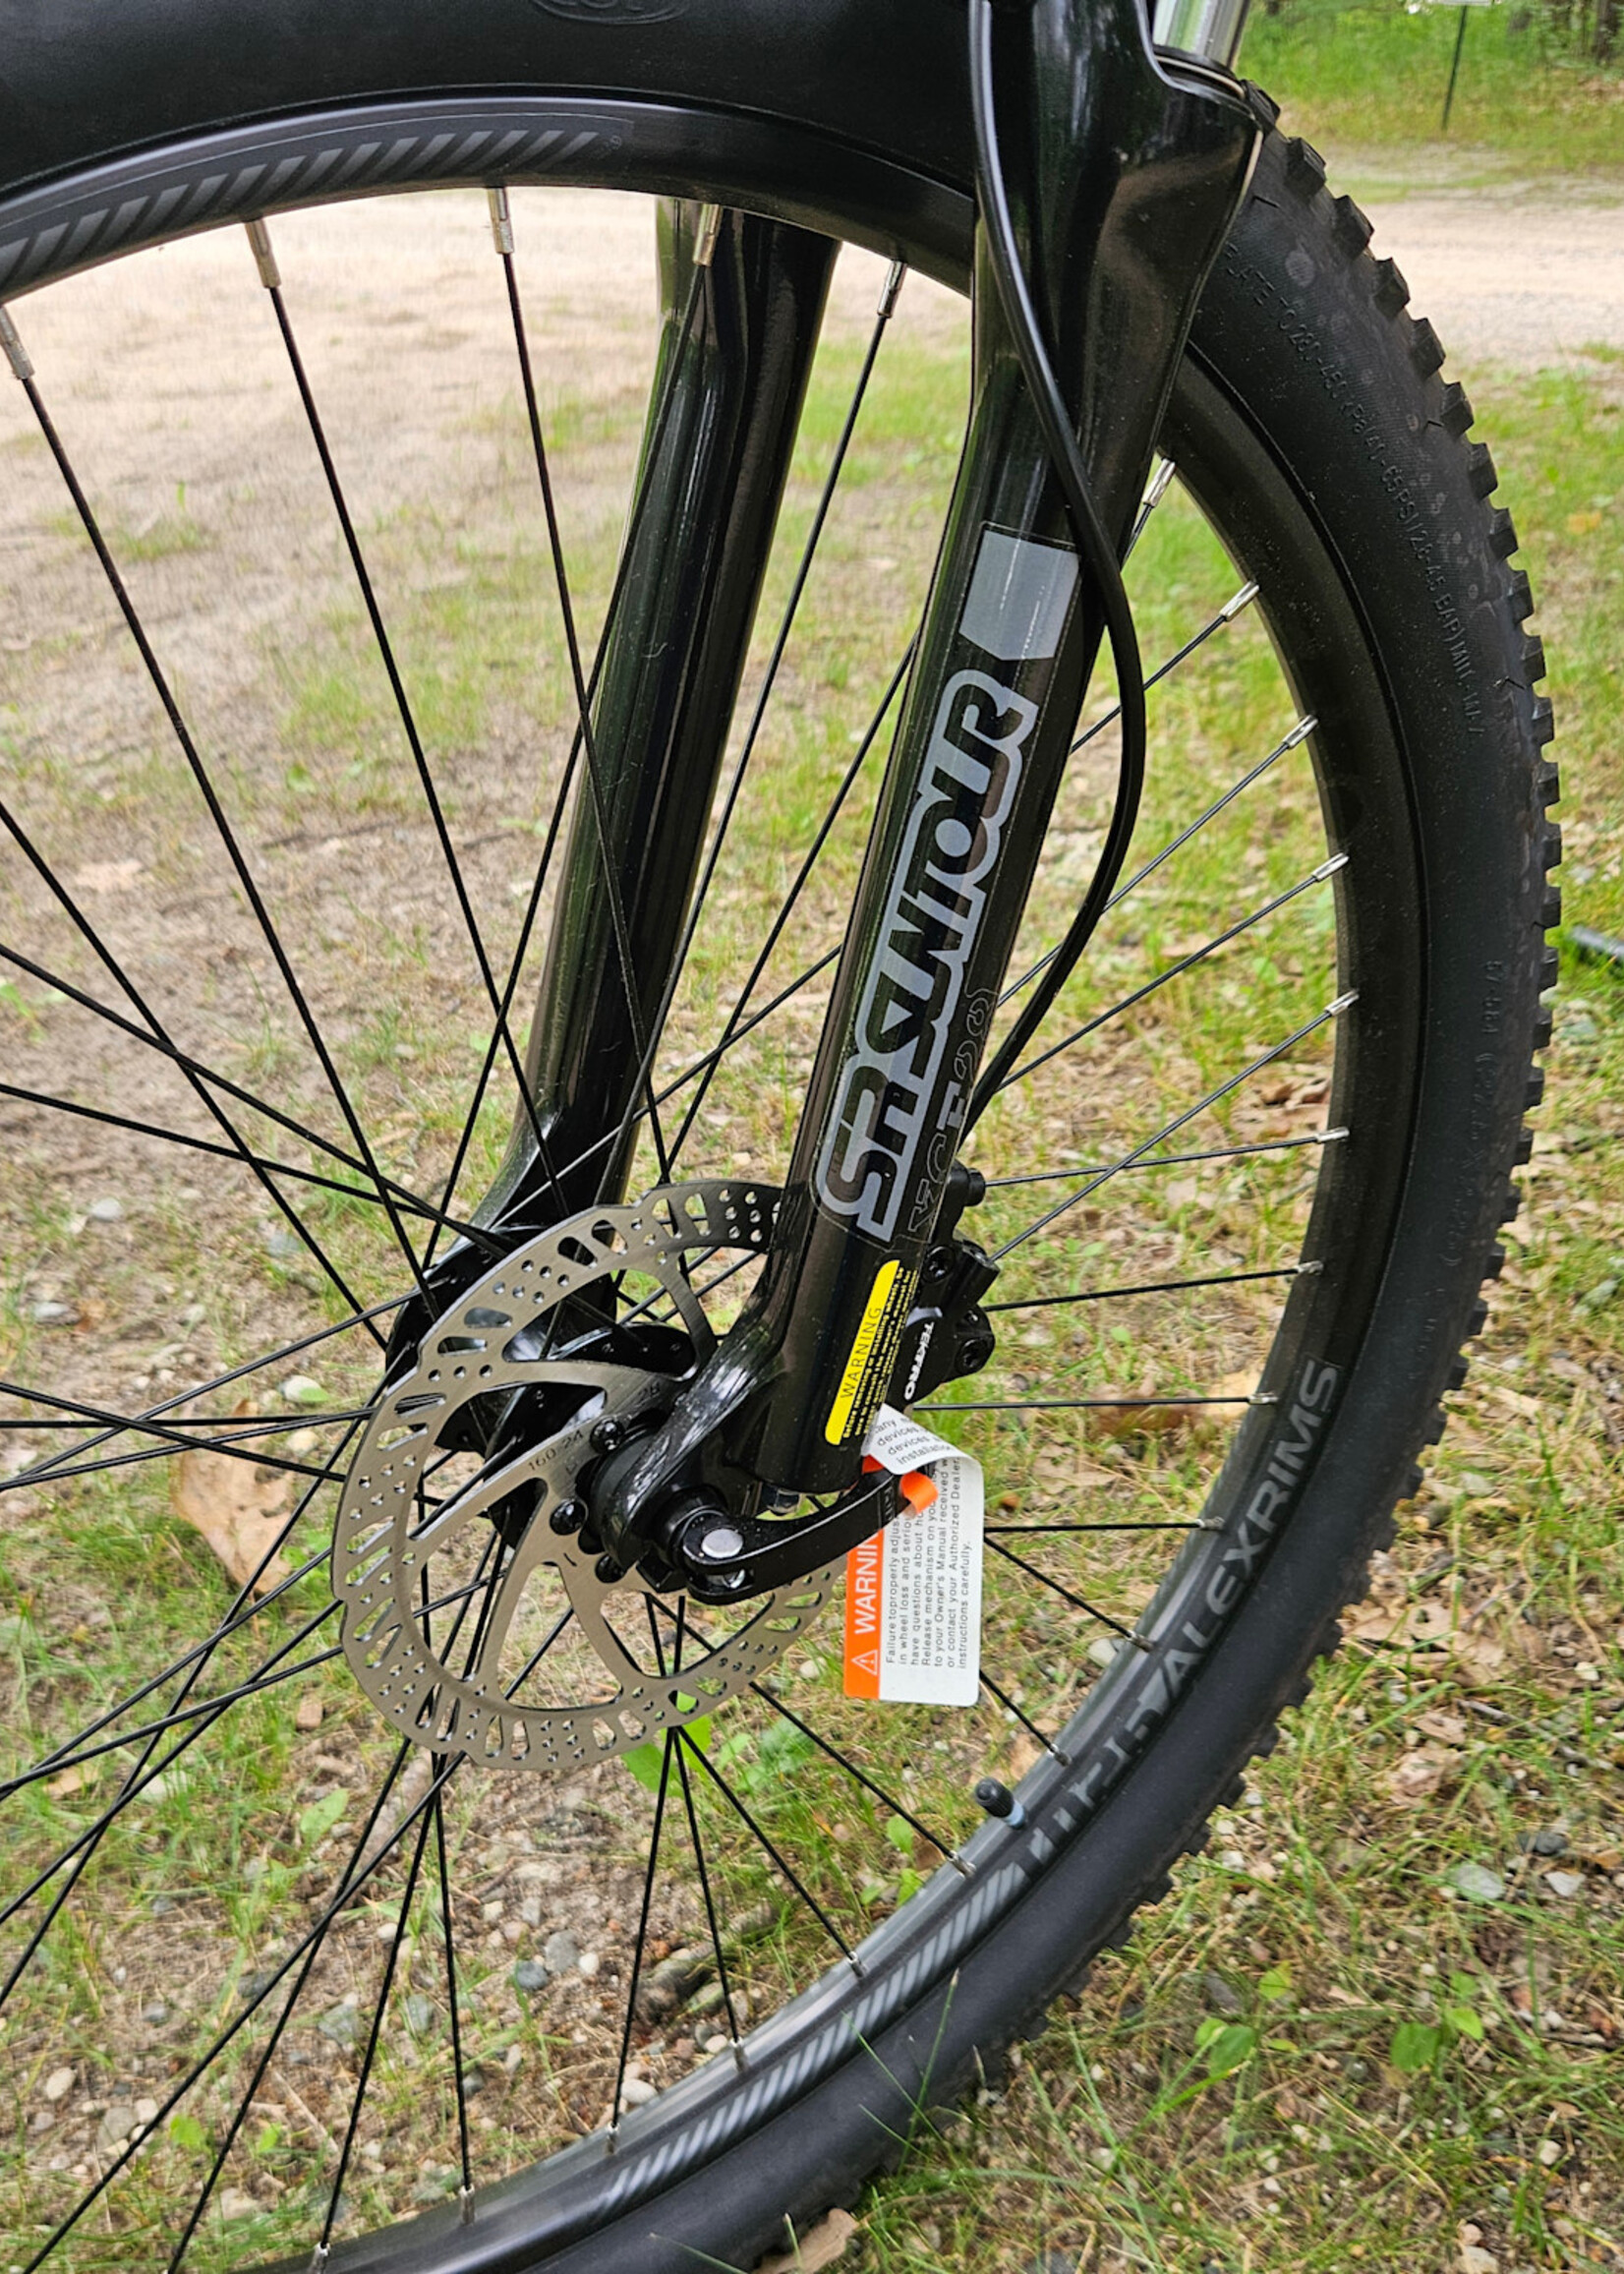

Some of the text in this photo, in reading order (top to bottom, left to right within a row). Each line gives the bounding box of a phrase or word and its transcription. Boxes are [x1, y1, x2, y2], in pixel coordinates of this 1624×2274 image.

[855, 669, 1040, 1079] SUNTOUR
[841, 1306, 883, 1400] WARNING
[939, 1471, 949, 1522] received
[891, 1516, 900, 1553] adjus
[927, 1526, 935, 1541] on
[937, 1528, 946, 1570] Manual
[949, 1504, 959, 1570] Authorized
[1164, 1360, 1338, 1692] ALEXRIMS
[854, 1532, 878, 1634] WARNIN
[911, 1574, 921, 1631] questions
[924, 1546, 934, 1613] mechanism
[935, 1575, 945, 1622] Owner's
[949, 1577, 957, 1603] your
[886, 1623, 897, 1663] Failure
[911, 1638, 920, 1665] have
[922, 1619, 931, 1665] Release
[948, 1608, 957, 1651] contact
[958, 1601, 968, 1668] instructions
[899, 1654, 907, 1664] in
[935, 1657, 943, 1666] to
[948, 1657, 955, 1667] or
